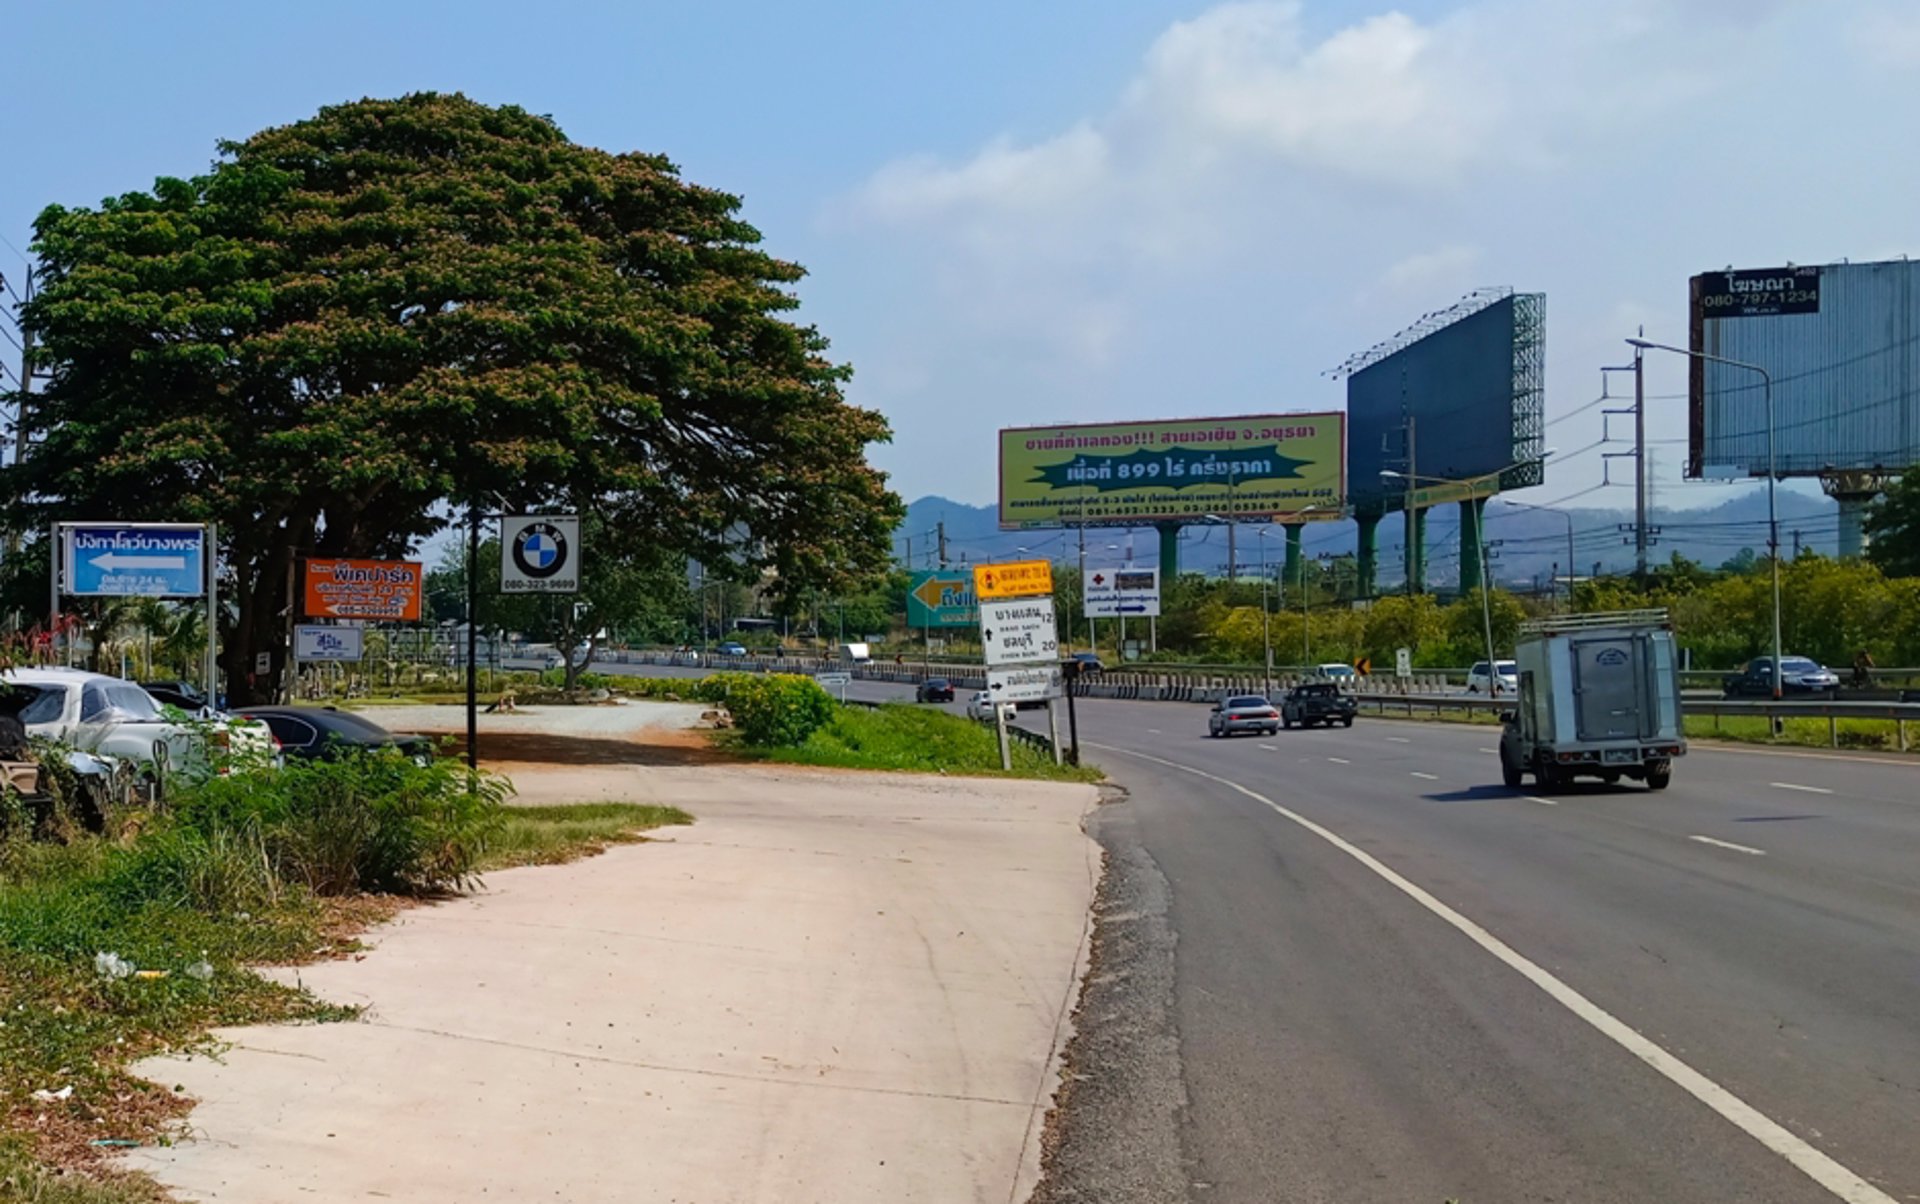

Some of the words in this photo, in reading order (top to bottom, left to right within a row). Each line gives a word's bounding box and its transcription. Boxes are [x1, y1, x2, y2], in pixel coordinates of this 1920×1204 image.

[1725, 273, 1794, 293] โฆษณา
[1704, 290, 1817, 307] 080-797-1234
[1067, 459, 1111, 481] เนื้อที่
[1118, 463, 1160, 479] 899
[1165, 457, 1185, 477] ไร่
[519, 525, 563, 542] BMW
[1041, 612, 1053, 623] 12
[1003, 632, 1034, 650] ชลบุรี
[1041, 641, 1057, 651] 20
